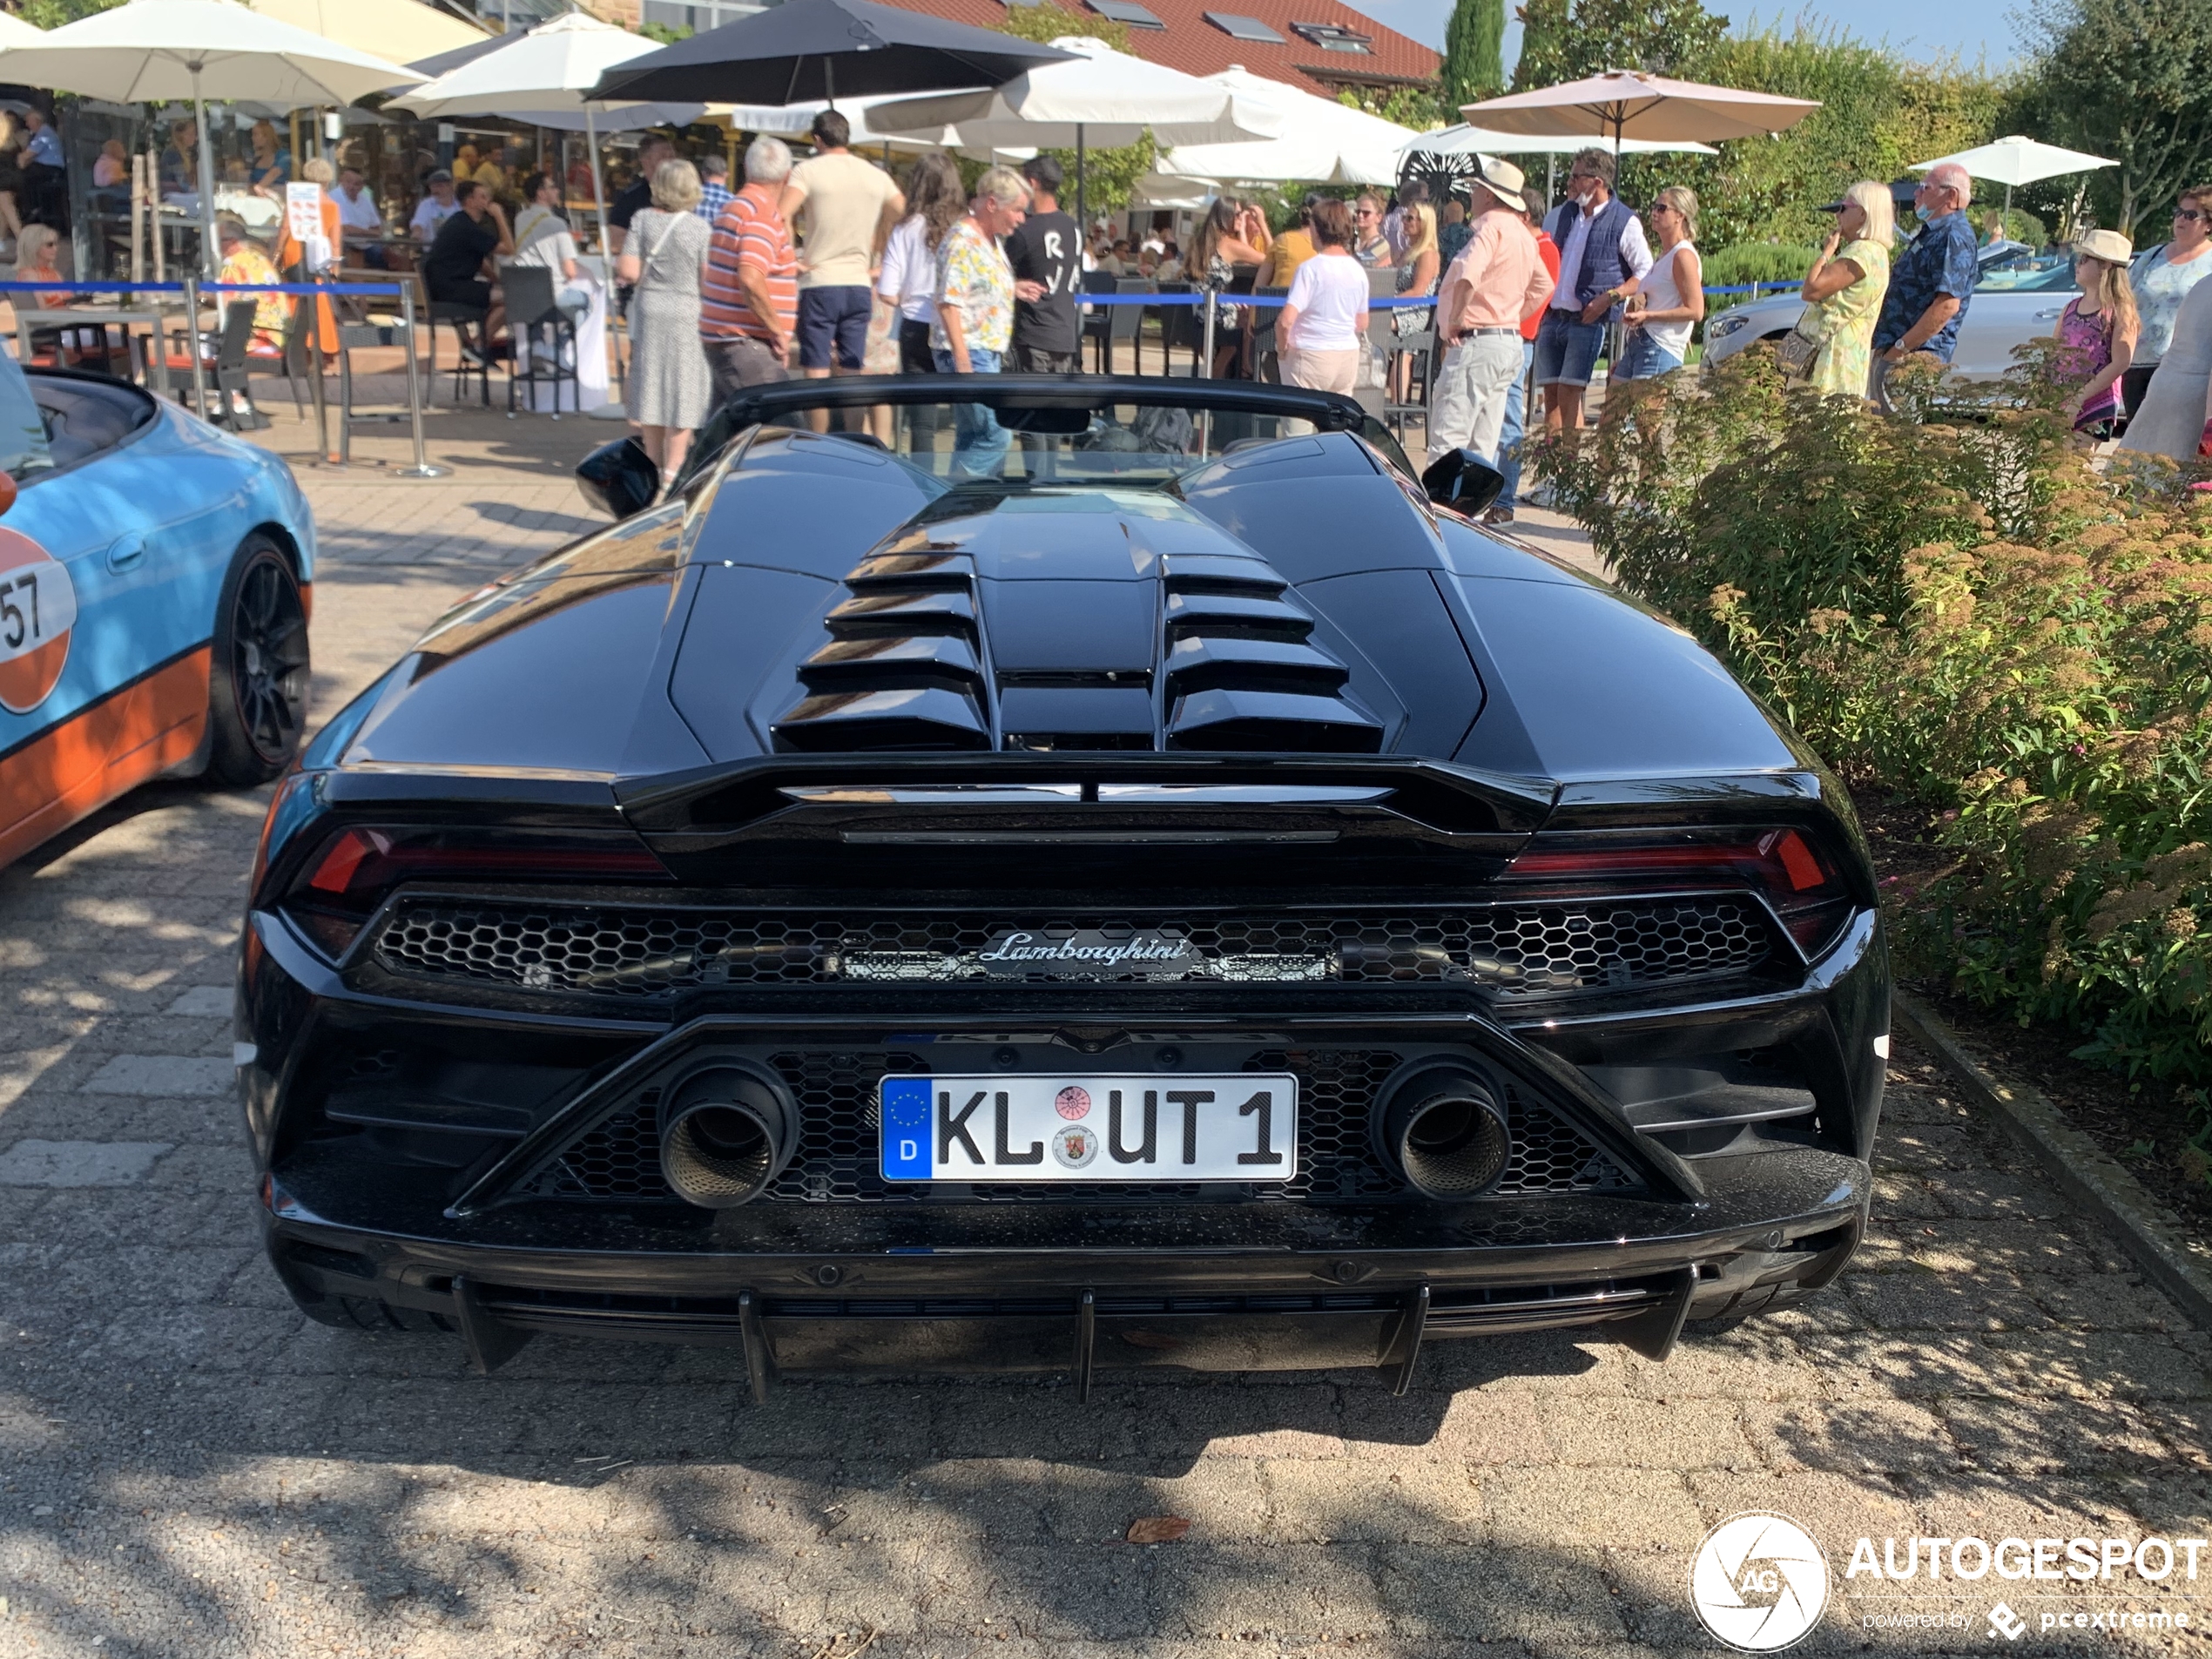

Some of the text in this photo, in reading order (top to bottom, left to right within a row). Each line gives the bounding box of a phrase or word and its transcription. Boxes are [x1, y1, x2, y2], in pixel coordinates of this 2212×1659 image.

[0, 572, 40, 649] 57
[979, 932, 1187, 967] Lamborghini
[900, 1139, 917, 1161] D
[938, 1090, 1044, 1165] KL
[1108, 1089, 1216, 1165] UT
[1237, 1090, 1283, 1165] 1
